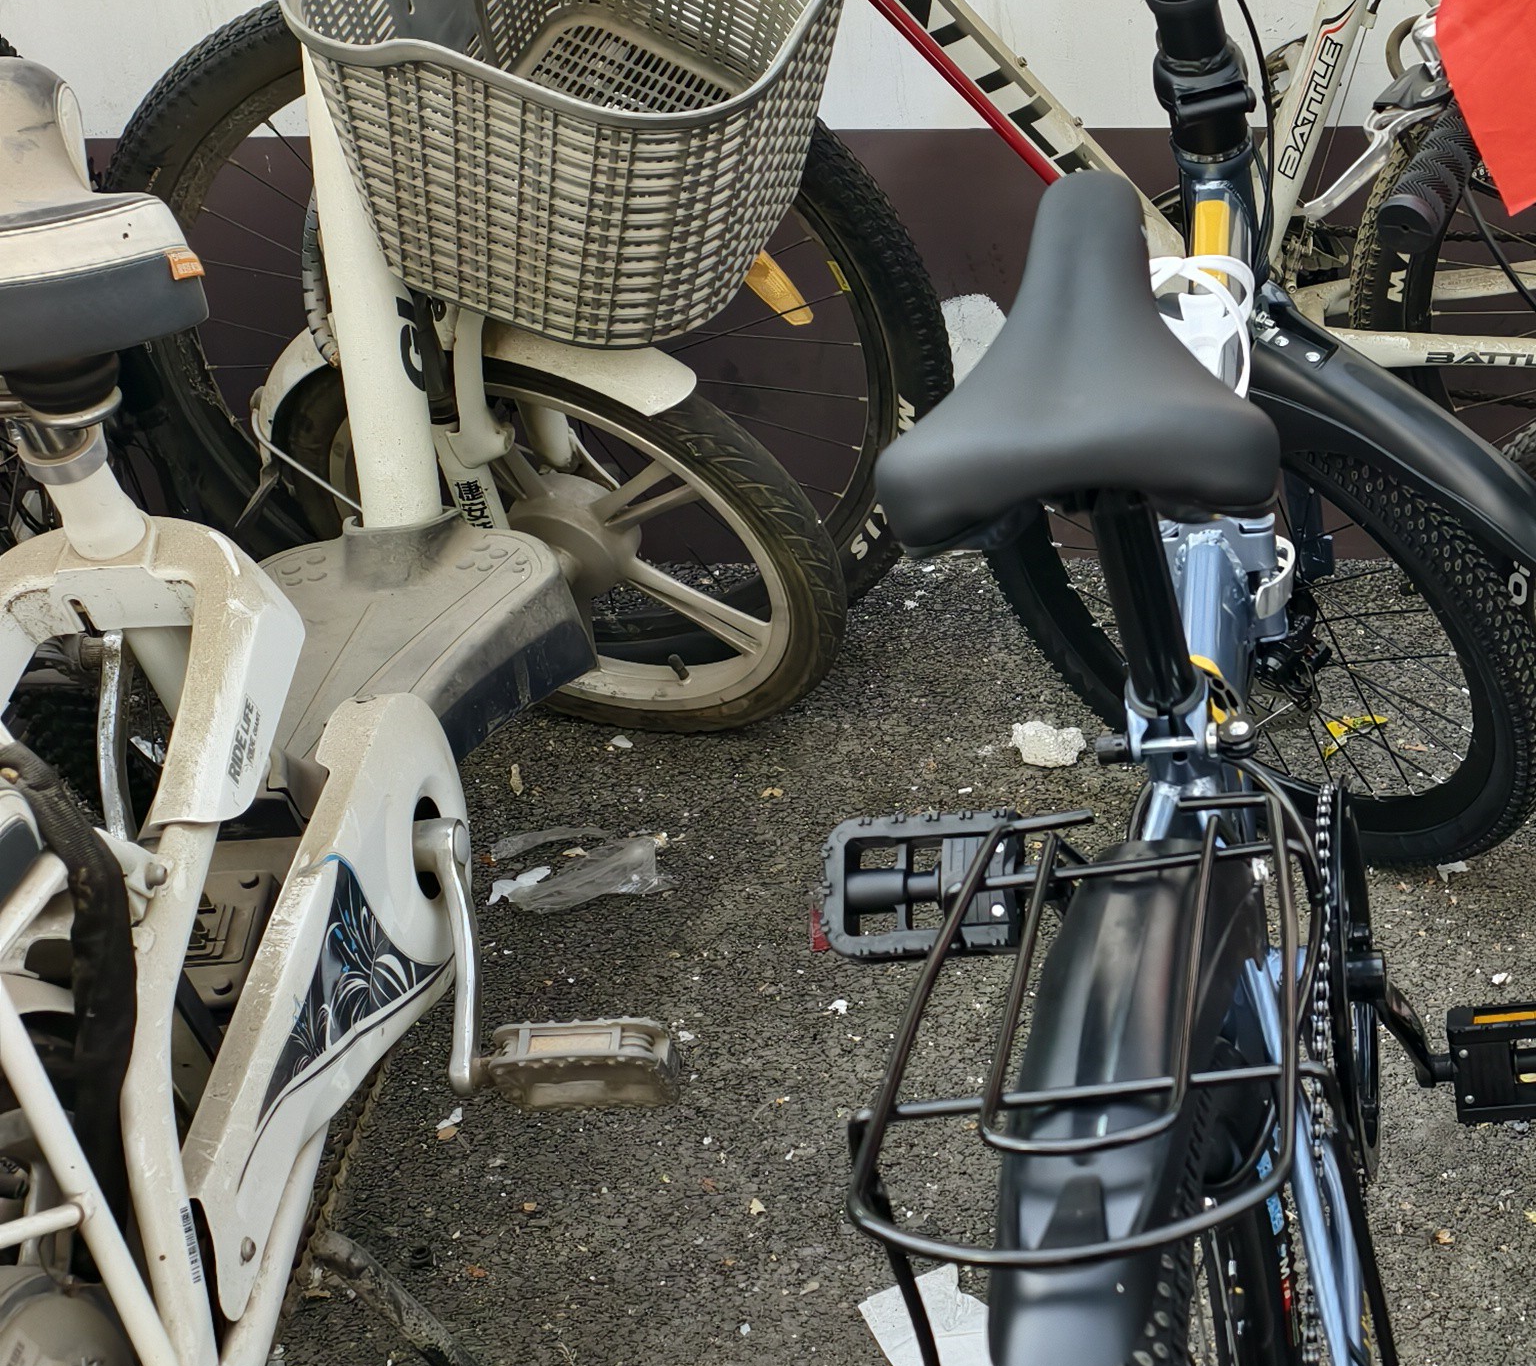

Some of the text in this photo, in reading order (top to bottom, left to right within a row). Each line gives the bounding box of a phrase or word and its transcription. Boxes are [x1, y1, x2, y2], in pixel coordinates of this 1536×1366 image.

[1279, 37, 1342, 180] BATTLE
[228, 698, 254, 786] RIDE LIFE
